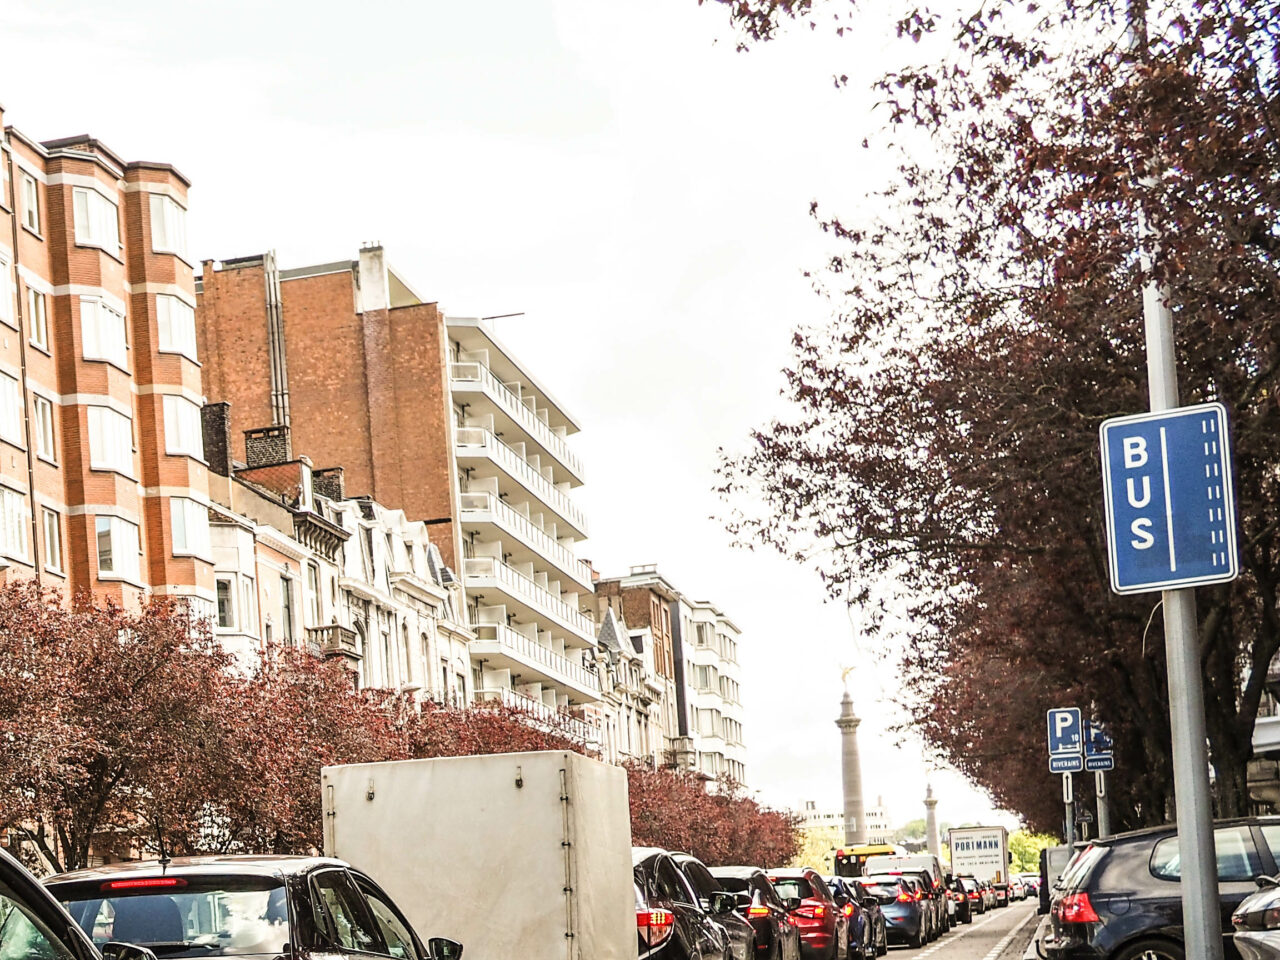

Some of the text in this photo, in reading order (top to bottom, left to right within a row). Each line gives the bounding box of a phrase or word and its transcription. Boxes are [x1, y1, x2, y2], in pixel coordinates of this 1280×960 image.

[1123, 436, 1154, 550] BUS
[1055, 712, 1073, 738] P
[1052, 760, 1080, 768] RIVERAINS
[955, 840, 999, 851] PORTMANN
